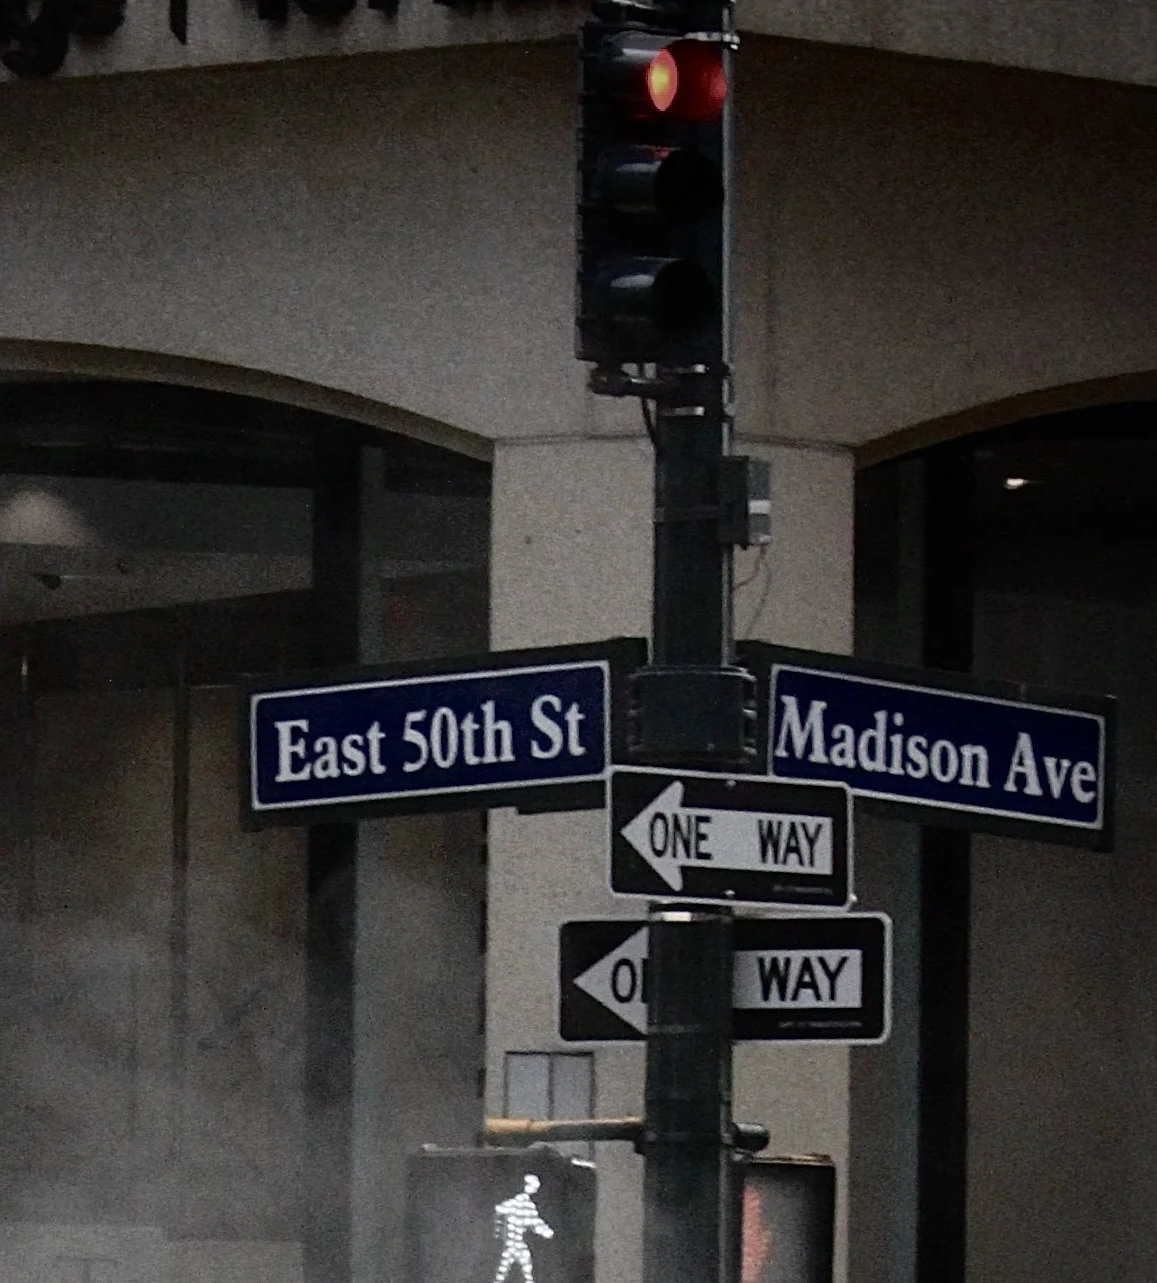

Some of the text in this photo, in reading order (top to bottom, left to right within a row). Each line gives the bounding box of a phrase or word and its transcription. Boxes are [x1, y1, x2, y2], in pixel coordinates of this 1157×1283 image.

[274, 694, 587, 783] East 50th St
[775, 694, 1097, 803] Madison Ave
[649, 811, 823, 868] ONE WAY
[757, 956, 849, 1002] WAY
